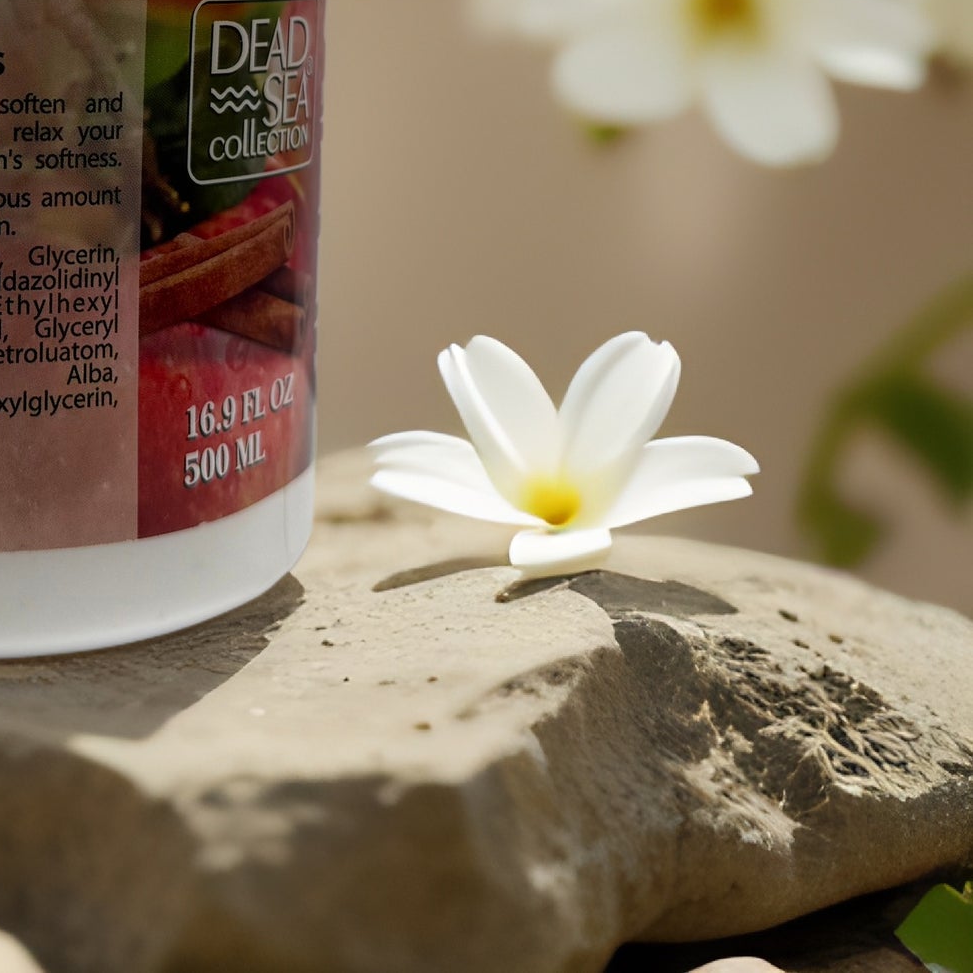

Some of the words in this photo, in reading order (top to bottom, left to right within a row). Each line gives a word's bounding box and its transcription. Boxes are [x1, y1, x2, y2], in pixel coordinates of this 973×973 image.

[210, 16, 310, 76] DEAD
[0, 93, 65, 114] soften
[85, 91, 123, 113] and
[13, 120, 64, 142] relax
[78, 124, 123, 146] your
[35, 148, 122, 170] softness.
[41, 186, 122, 208] amount
[28, 243, 120, 271] Glycerin,
[34, 312, 118, 343] Glyceryl
[67, 362, 118, 385] Alba,
[186, 395, 237, 441] 16.9
[242, 386, 266, 424] FL
[269, 372, 295, 412] OZ
[184, 442, 230, 489] 500
[235, 430, 266, 472] ML
